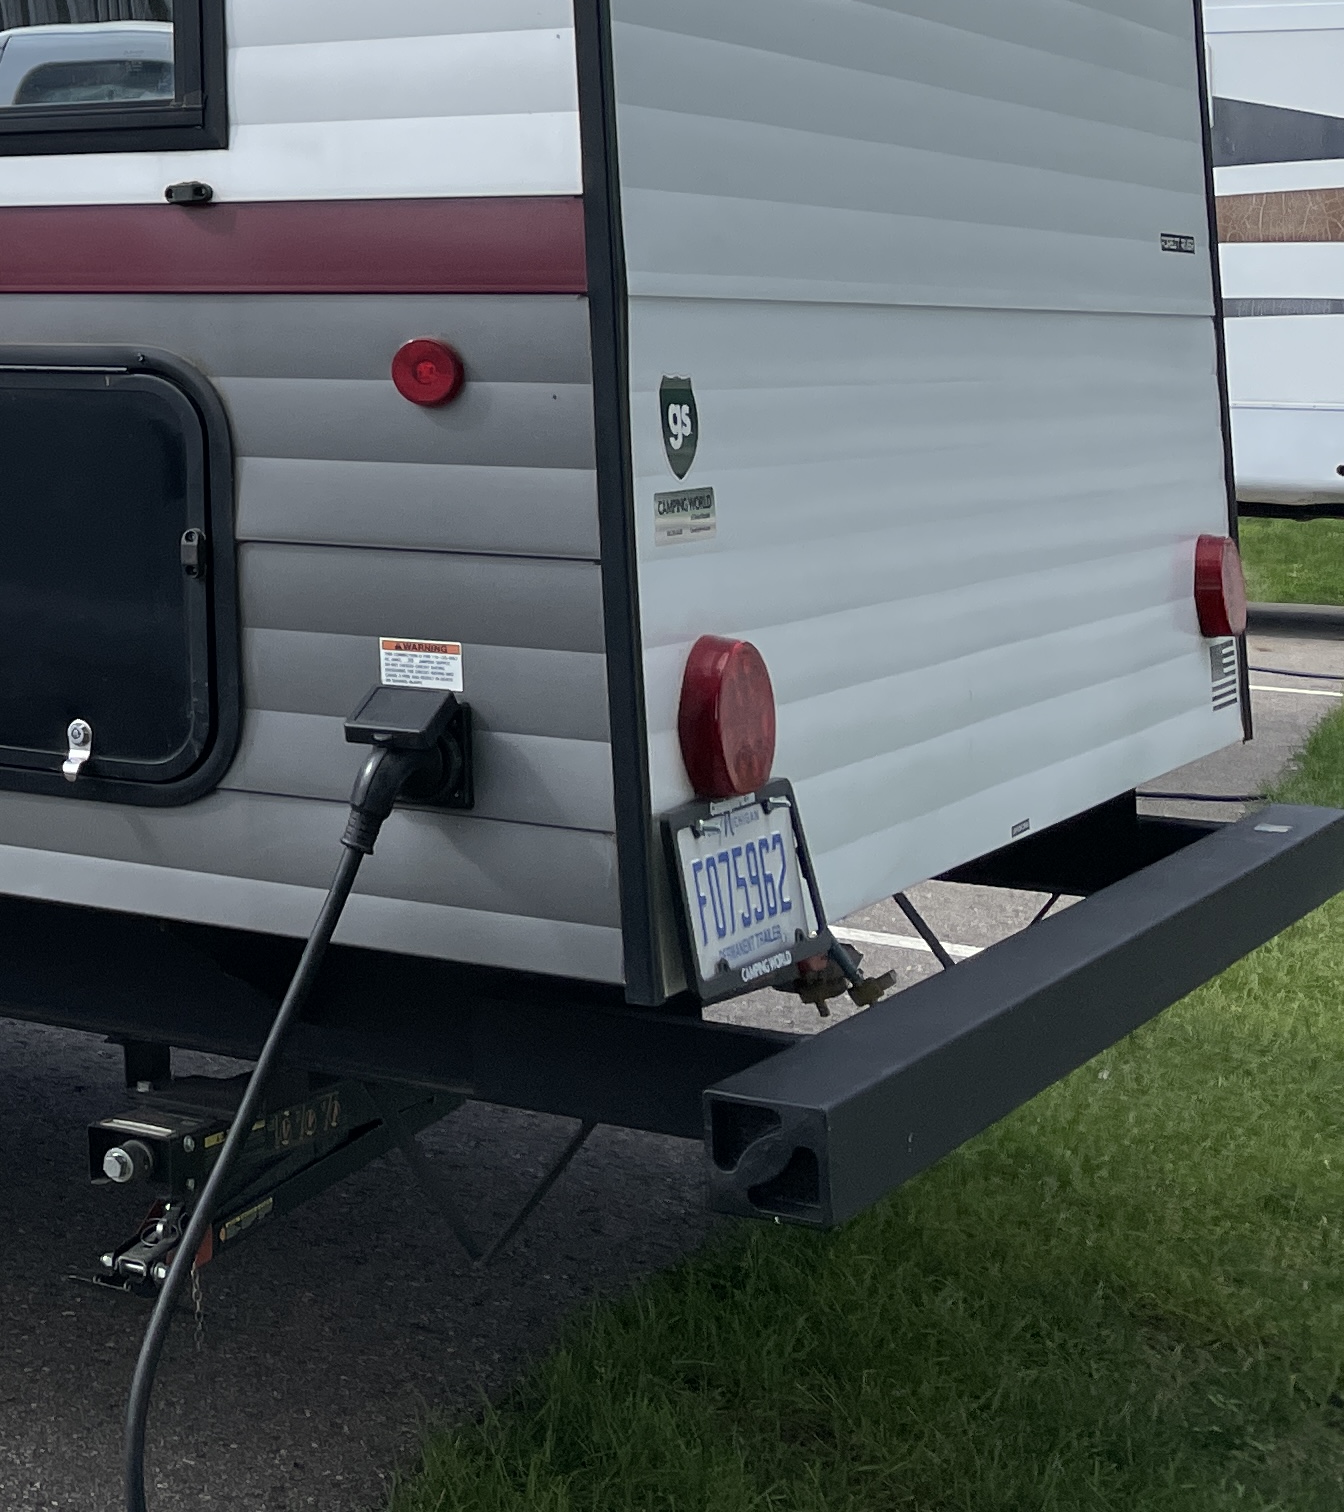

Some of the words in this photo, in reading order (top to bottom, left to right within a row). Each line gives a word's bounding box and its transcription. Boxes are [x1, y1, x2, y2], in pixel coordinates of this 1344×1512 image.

[668, 403, 692, 450] gs
[658, 498, 688, 515] CAMPING
[688, 494, 712, 511] WORLD
[402, 643, 448, 653] WARNING
[691, 830, 792, 947] F075962
[741, 959, 770, 982] CAMPING
[769, 950, 792, 971] WORLD
